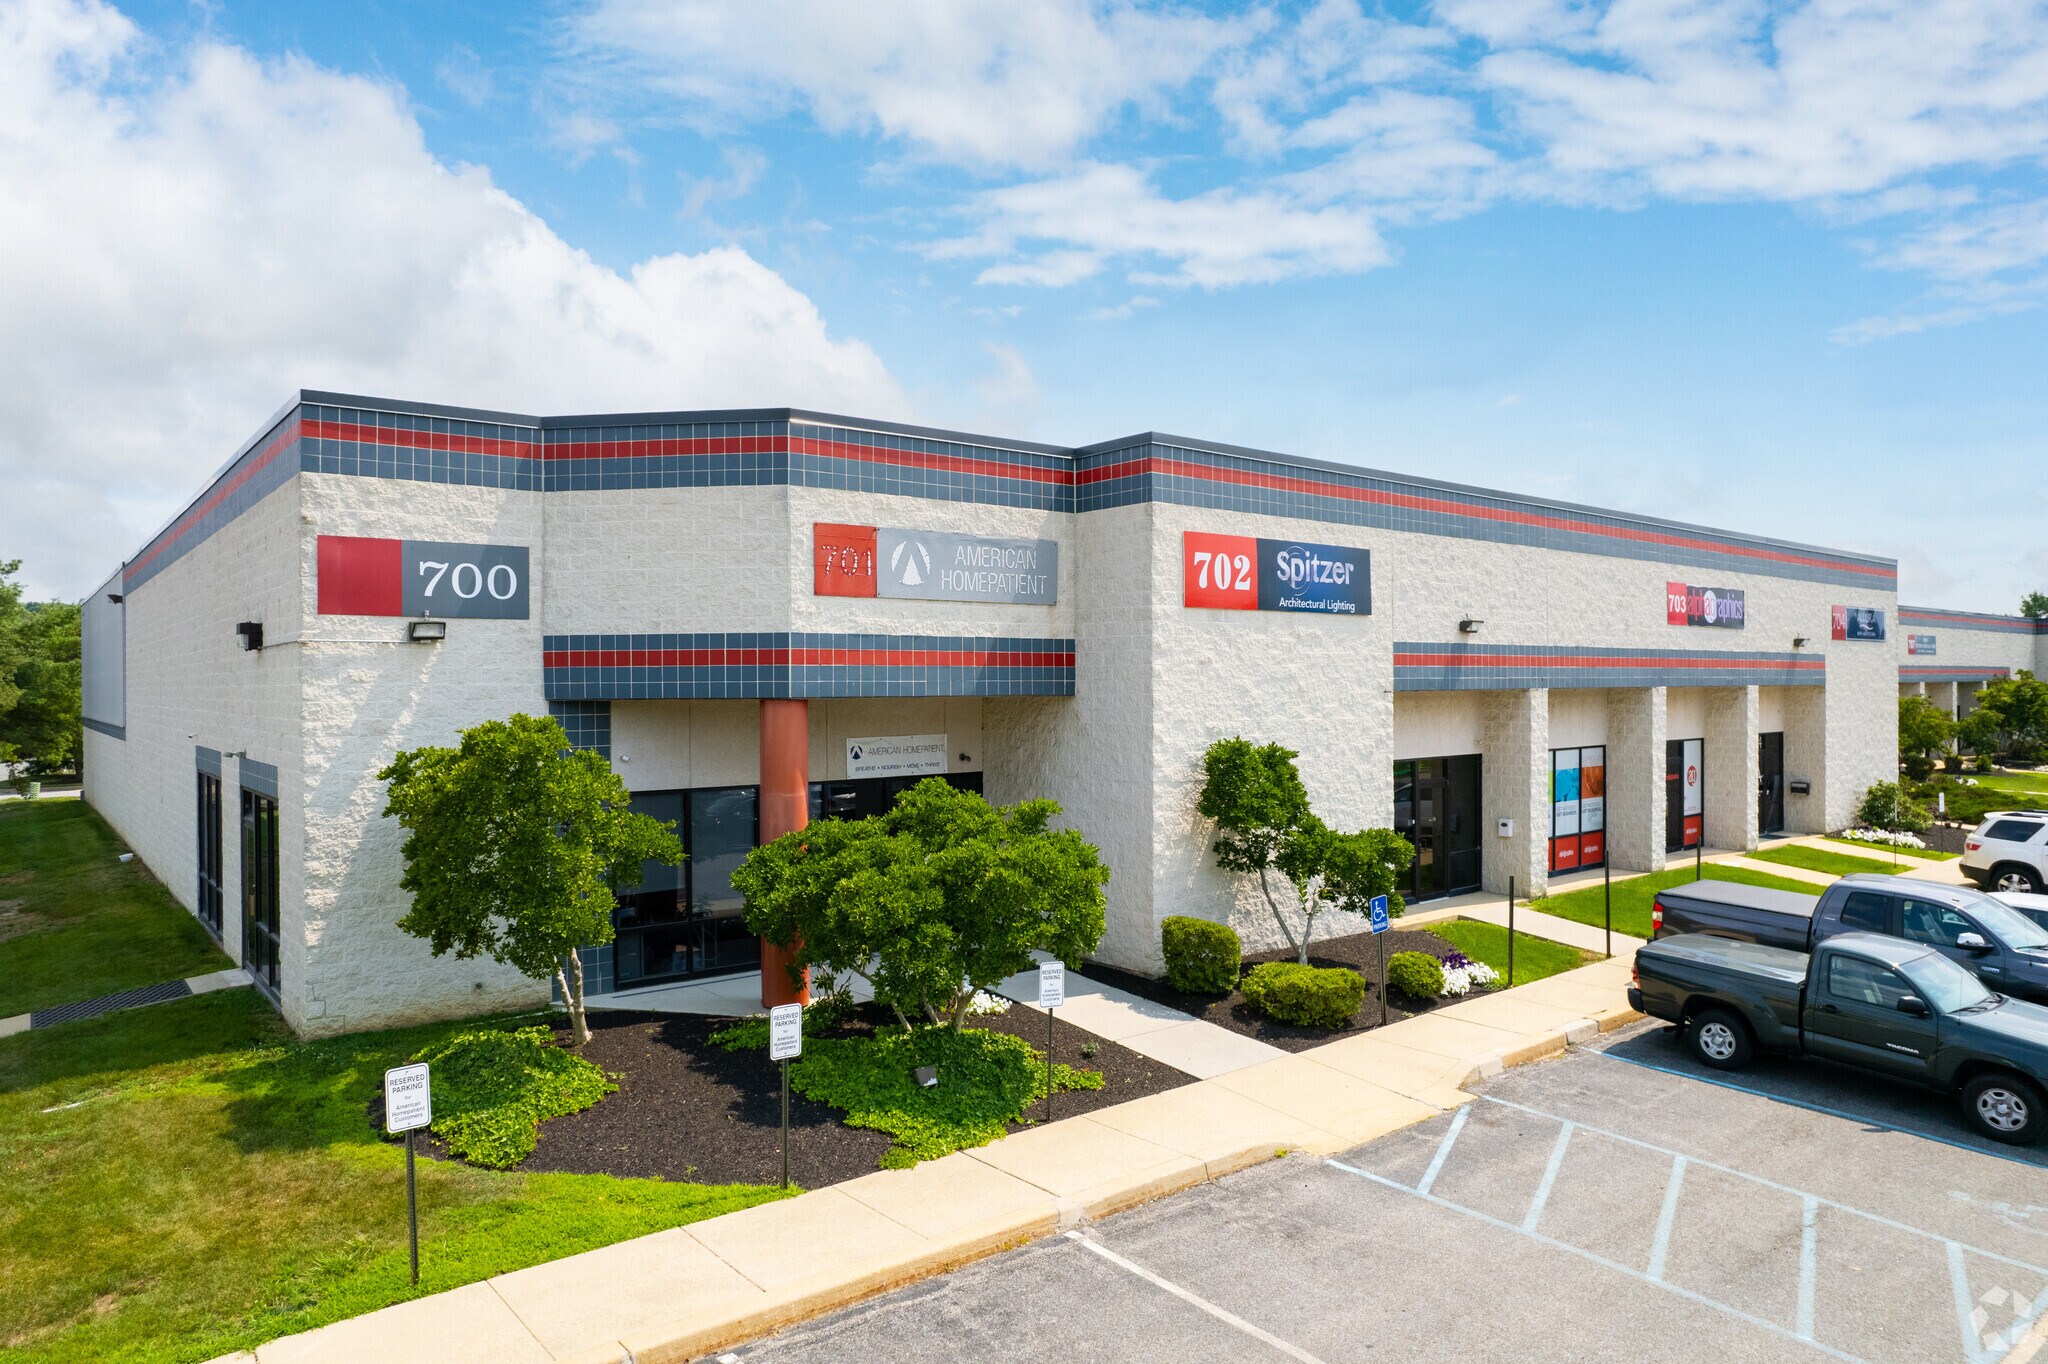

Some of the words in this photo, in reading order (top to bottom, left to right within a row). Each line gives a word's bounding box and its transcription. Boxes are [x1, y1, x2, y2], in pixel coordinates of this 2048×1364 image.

[822, 545, 872, 577] 701
[954, 545, 1037, 570] AMERICAN
[1193, 551, 1251, 591] 702
[1276, 550, 1355, 589] Spitzer
[419, 561, 518, 600] 700
[941, 569, 1048, 595] HOMEPATIENT
[1279, 596, 1326, 609] Architectural
[1327, 600, 1356, 613] Lighting
[1668, 594, 1687, 613] 703
[1832, 612, 1846, 630] 704
[868, 745, 901, 756] AMERICAN
[902, 744, 945, 754] HOMEPATIENT
[773, 1012, 799, 1021] RESERVED
[775, 1019, 797, 1027] PARKING
[389, 1073, 425, 1087] RESERVED
[392, 1081, 423, 1094] PARKING
[391, 1106, 425, 1117] Homepatient
[396, 1101, 421, 1111] American
[394, 1112, 424, 1123] Customers
